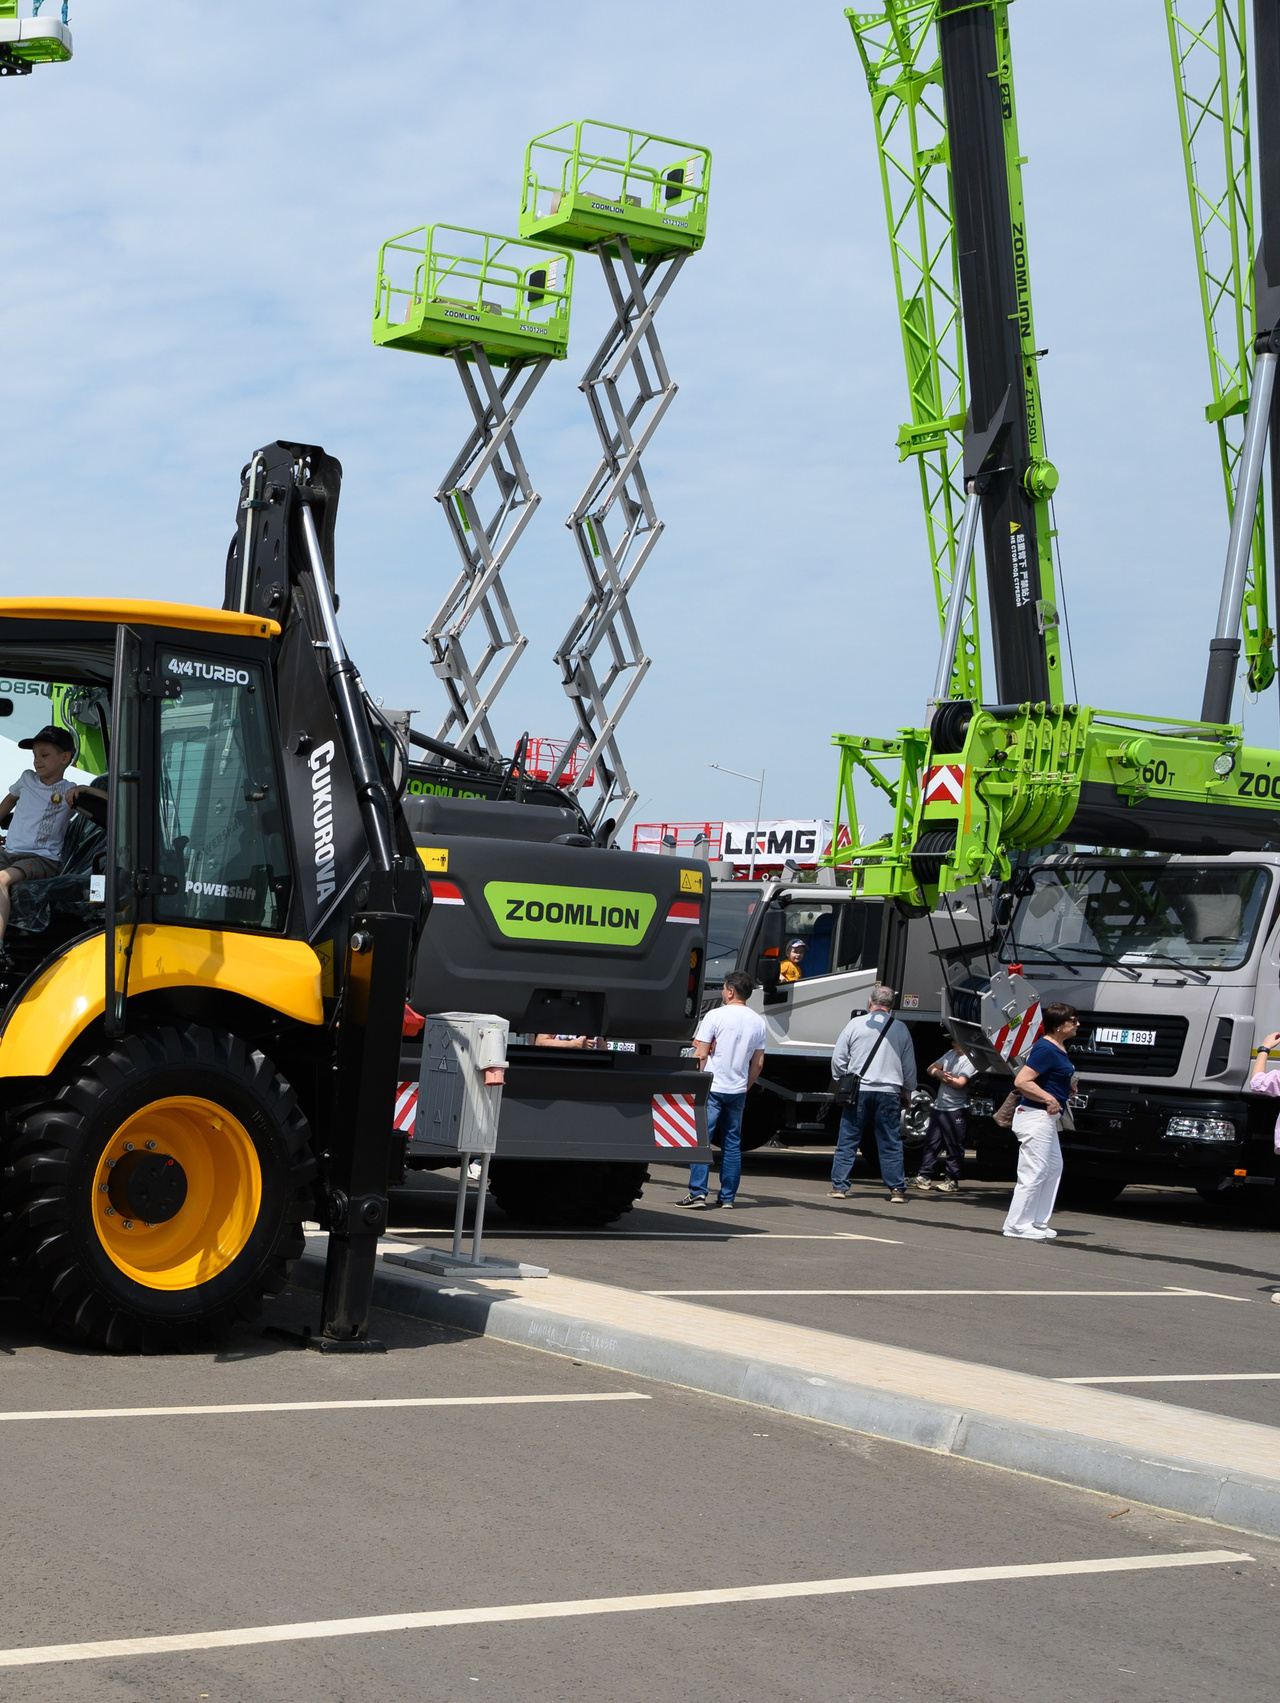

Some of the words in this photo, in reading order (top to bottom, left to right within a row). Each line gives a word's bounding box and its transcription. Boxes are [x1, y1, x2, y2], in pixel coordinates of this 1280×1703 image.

[591, 202, 625, 214] ZOOMLION
[1012, 222, 1031, 338] ZOOMLION
[444, 309, 481, 322] ZOOMLION
[1025, 387, 1038, 444] ZTF250V
[308, 740, 336, 905] ÇUKUROVA
[724, 830, 817, 855] LGMG
[506, 899, 639, 930] ZOOMLION
